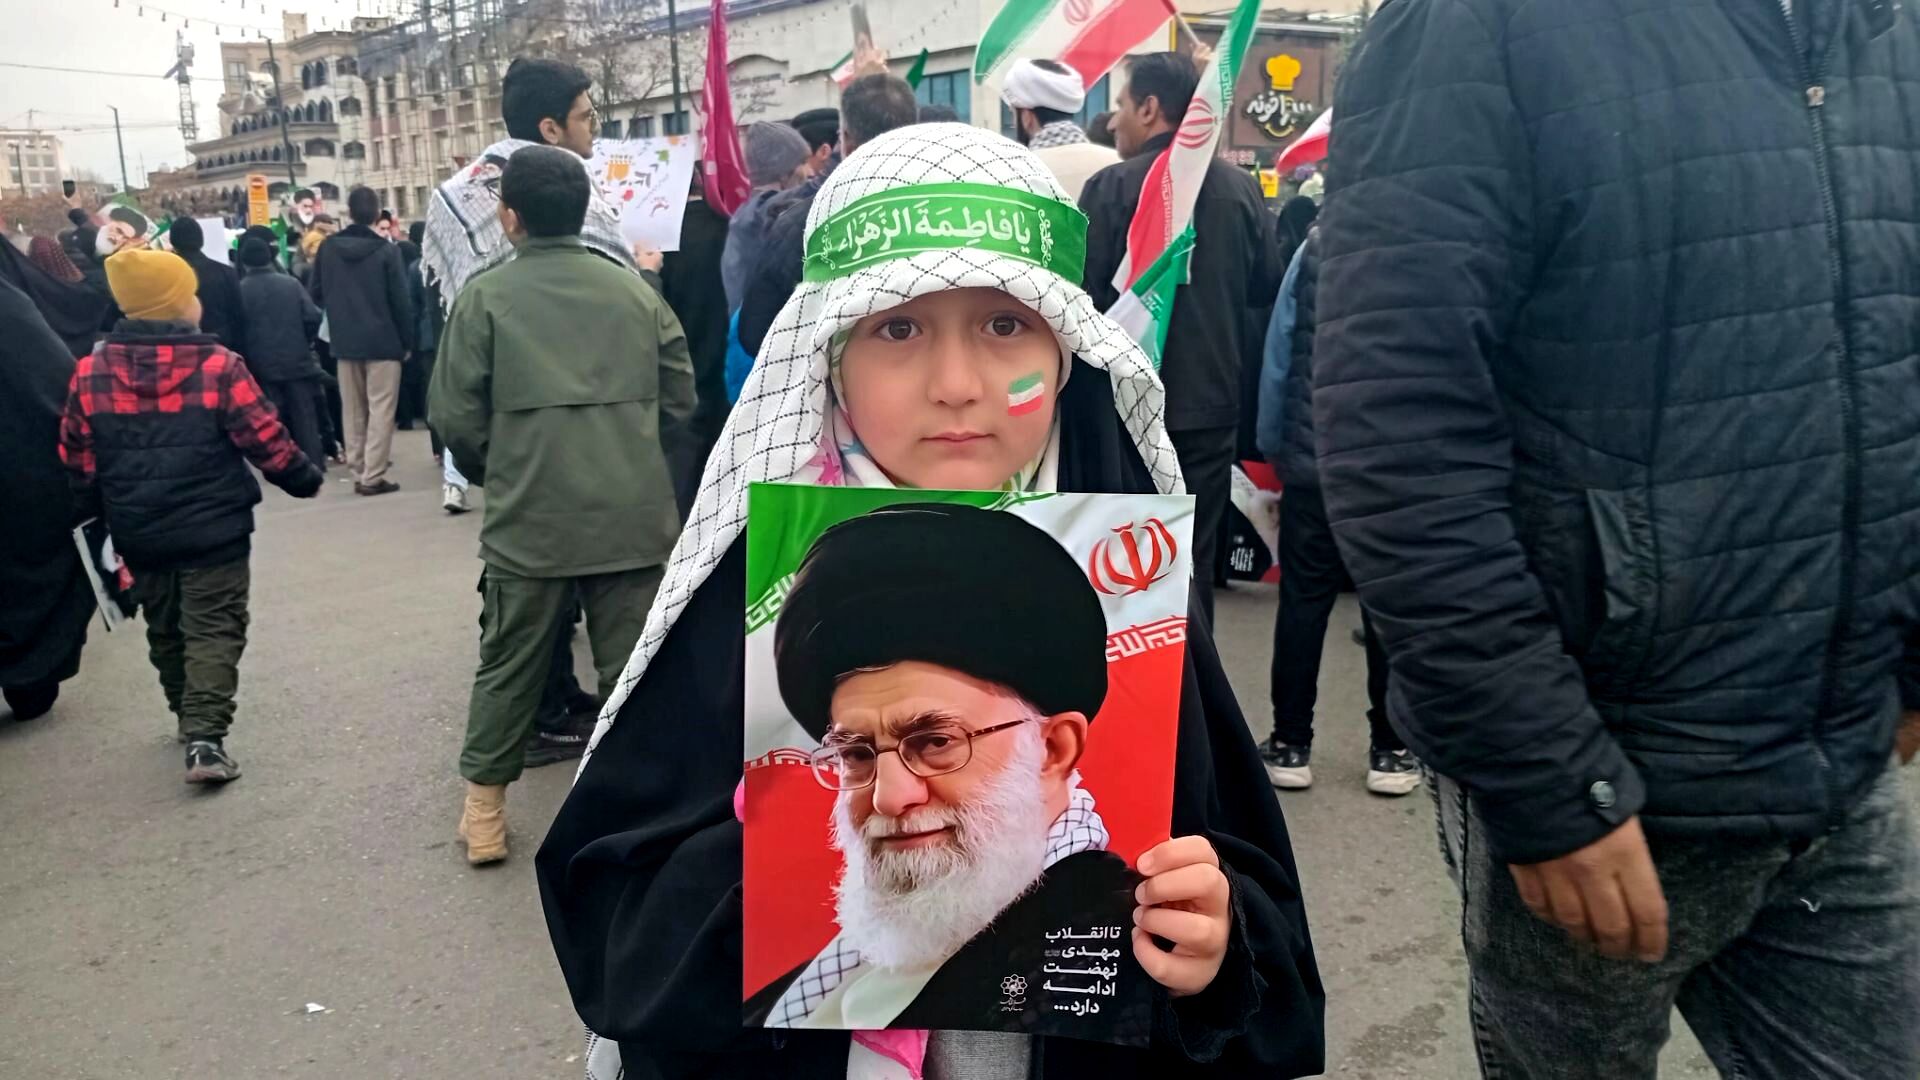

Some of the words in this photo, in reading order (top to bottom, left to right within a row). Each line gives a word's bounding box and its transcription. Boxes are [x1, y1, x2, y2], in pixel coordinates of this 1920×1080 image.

[1045, 926, 1108, 943] انقلاب
[1061, 945, 1120, 961] مهدی
[1043, 961, 1118, 980] نهضت
[1043, 979, 1116, 996] ادامه
